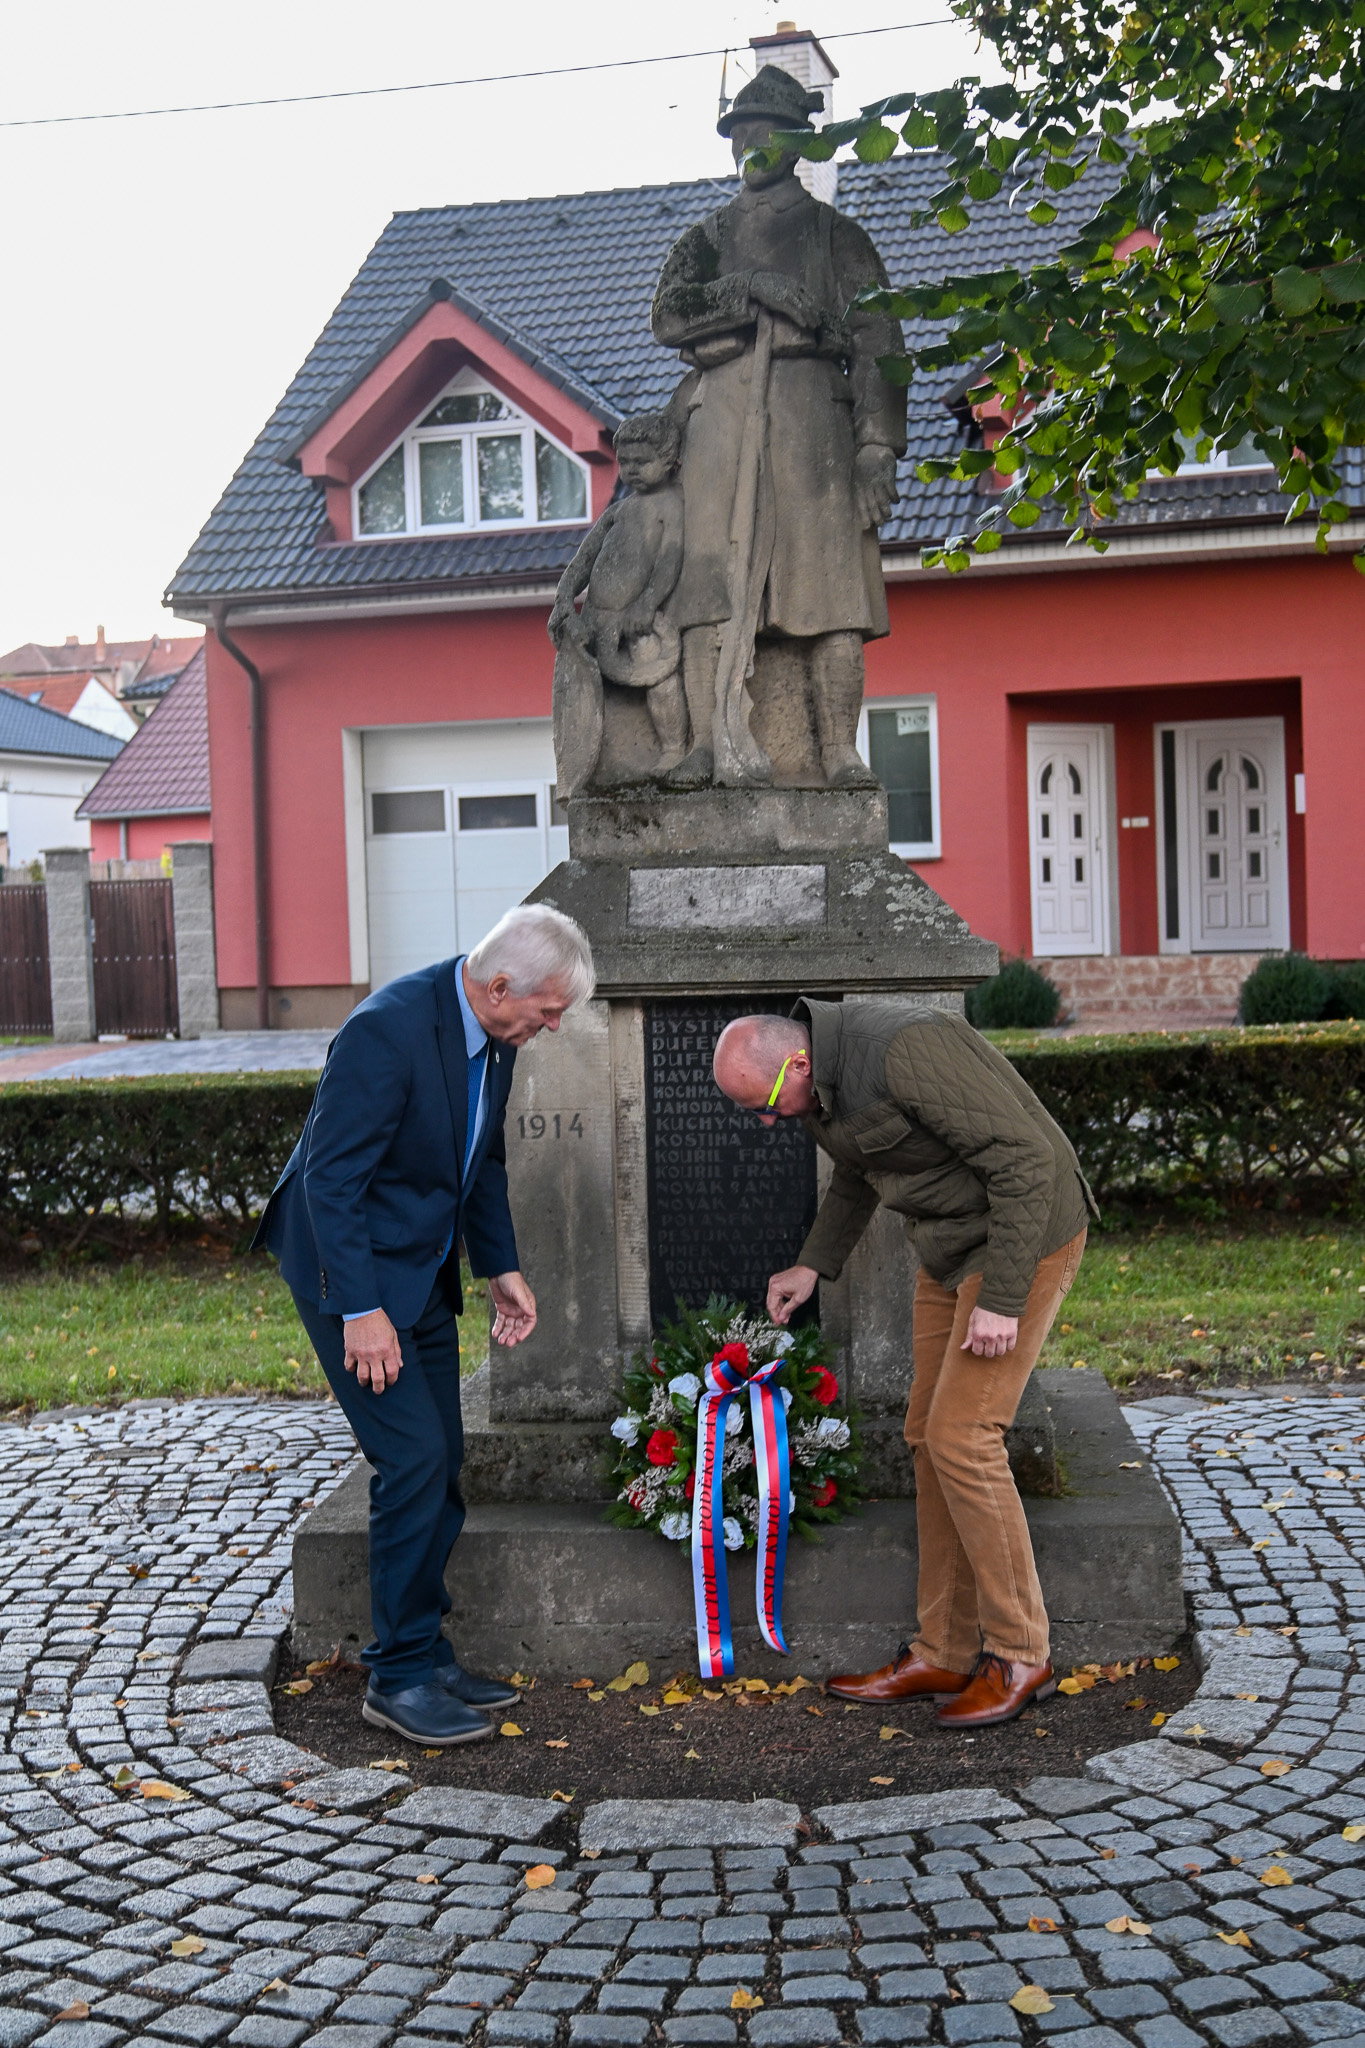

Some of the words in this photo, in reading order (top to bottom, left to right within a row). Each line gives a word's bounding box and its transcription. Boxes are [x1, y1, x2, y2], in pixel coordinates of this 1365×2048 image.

[653, 1053, 713, 1067] DUFE
[653, 1086, 723, 1099] HOCHMA
[652, 1101, 725, 1115] JAHODA
[517, 1113, 584, 1139] 1914
[655, 1132, 742, 1147] KOSTIHA
[763, 1132, 806, 1147] JAN
[710, 1646, 724, 1660] S
